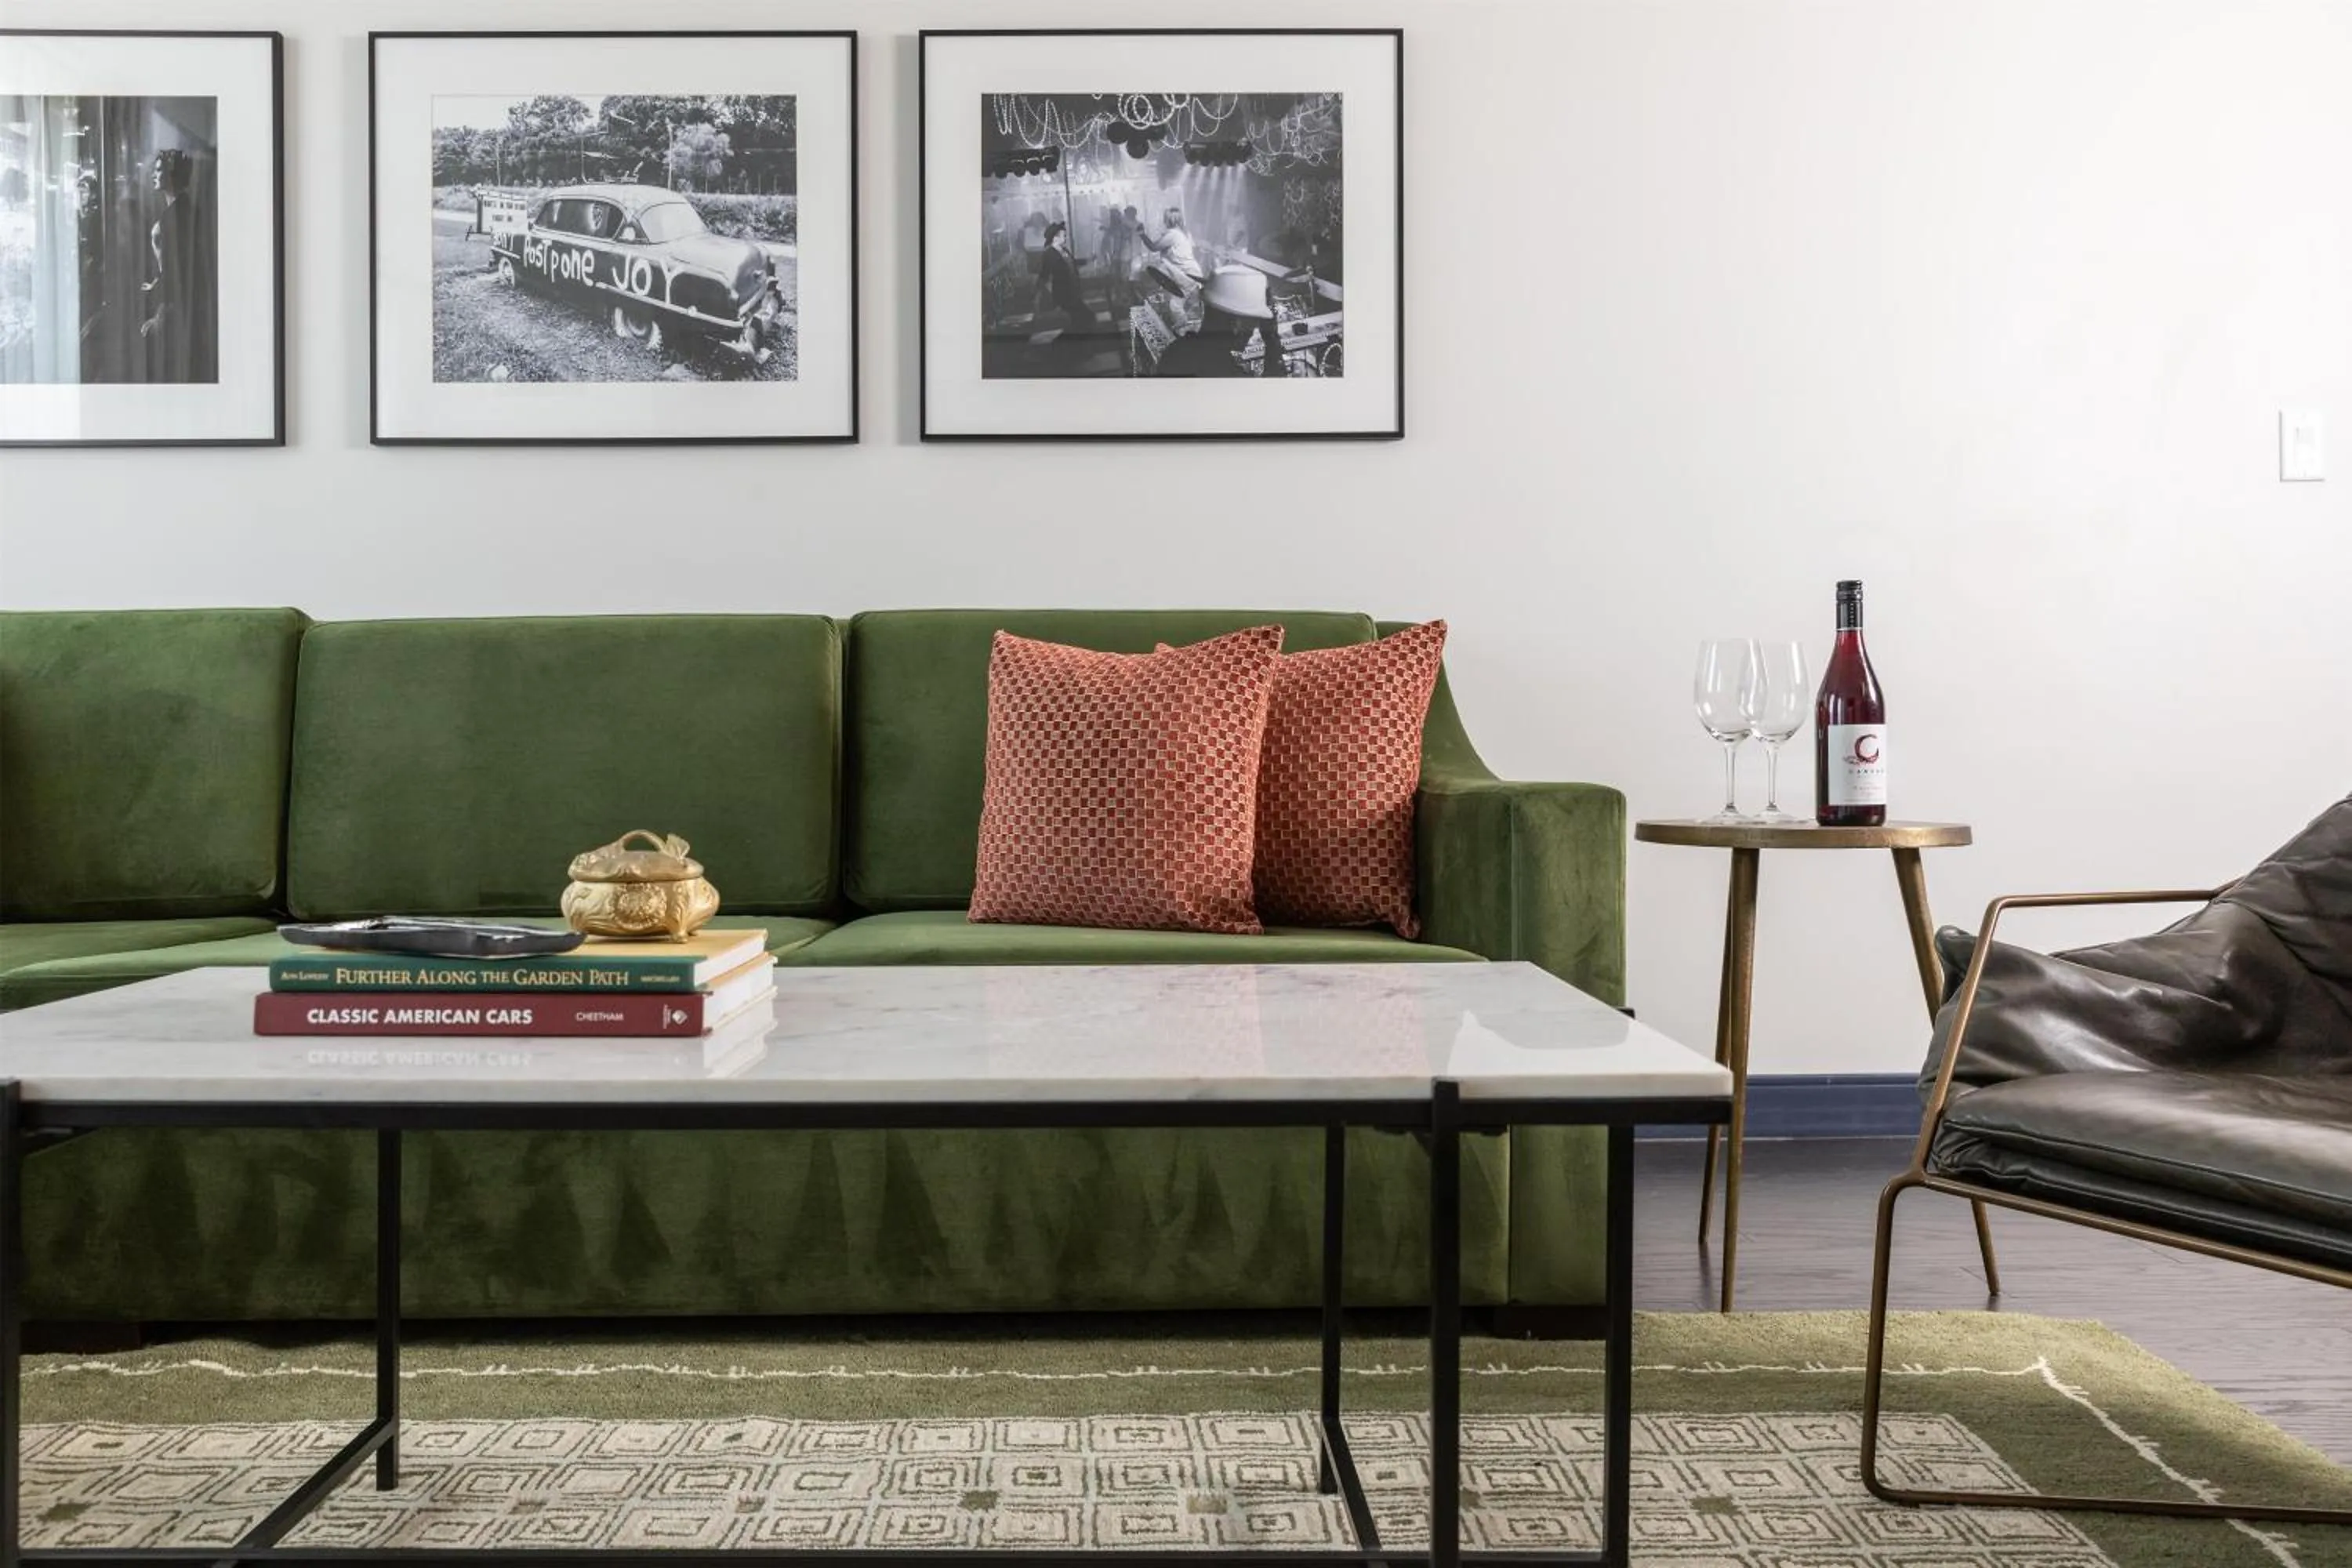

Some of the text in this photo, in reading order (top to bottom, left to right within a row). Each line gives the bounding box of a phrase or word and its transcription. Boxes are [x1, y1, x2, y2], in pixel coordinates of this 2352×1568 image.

[336, 967, 411, 985] FURTHER
[416, 968, 477, 985] ALONG
[481, 971, 510, 984] THE
[513, 968, 583, 985] GARDEN
[589, 968, 629, 985] PATH
[307, 1008, 379, 1024] CLASSIC
[383, 1008, 481, 1024] AMERICAN
[486, 1008, 534, 1025] CARS
